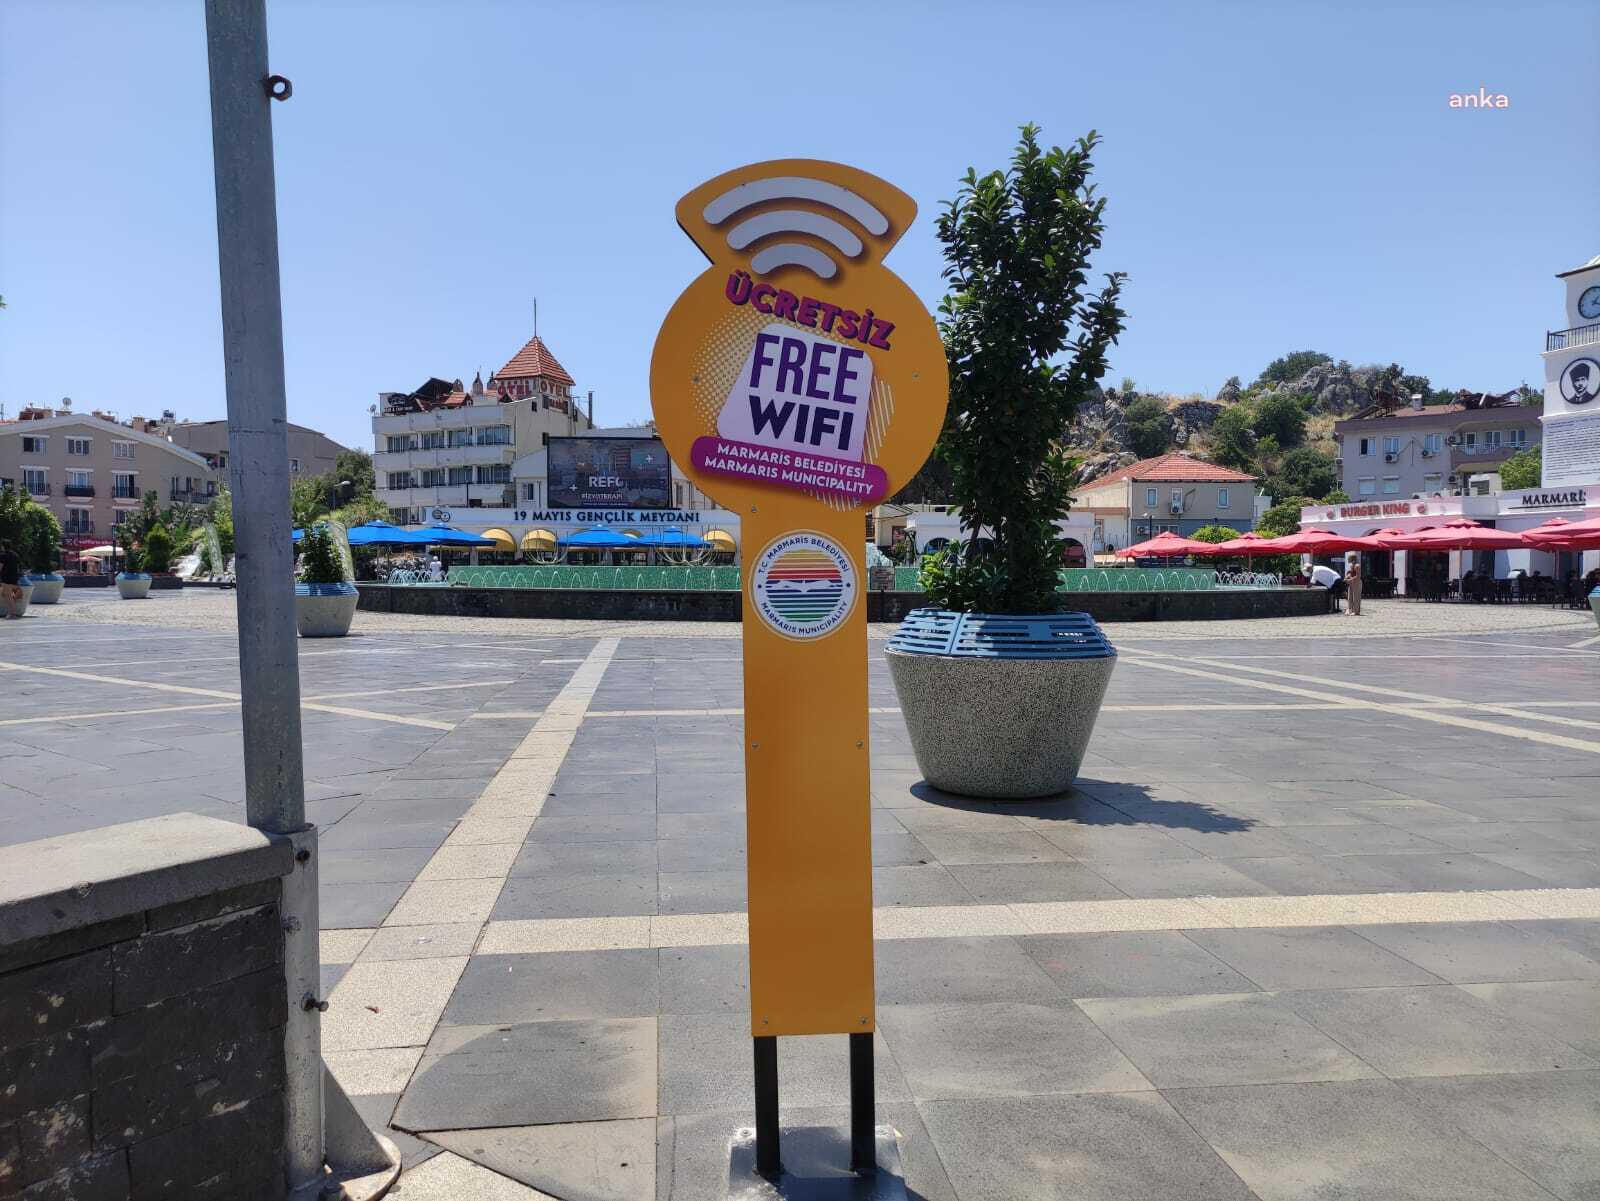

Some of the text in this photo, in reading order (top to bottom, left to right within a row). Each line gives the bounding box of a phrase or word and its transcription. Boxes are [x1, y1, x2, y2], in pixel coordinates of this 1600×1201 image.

[725, 268, 896, 352] ÜCRETSİZ
[749, 333, 865, 405] FREE
[748, 395, 855, 451] WIFI
[704, 456, 874, 495] MARMARIS MUNICIPALITY
[717, 443, 866, 479] MARMARİS BELEDİYESİ
[1340, 503, 1411, 518] BURGER KING
[1522, 489, 1586, 505] MARMARİ
[514, 509, 700, 524] 19 MAYIS GENÇLİK MEYDANI
[767, 536, 809, 561] MARMARİS
[810, 537, 851, 573] BELEDİYESİ
[760, 601, 848, 635] MARMARIS MUNICIPALITY
